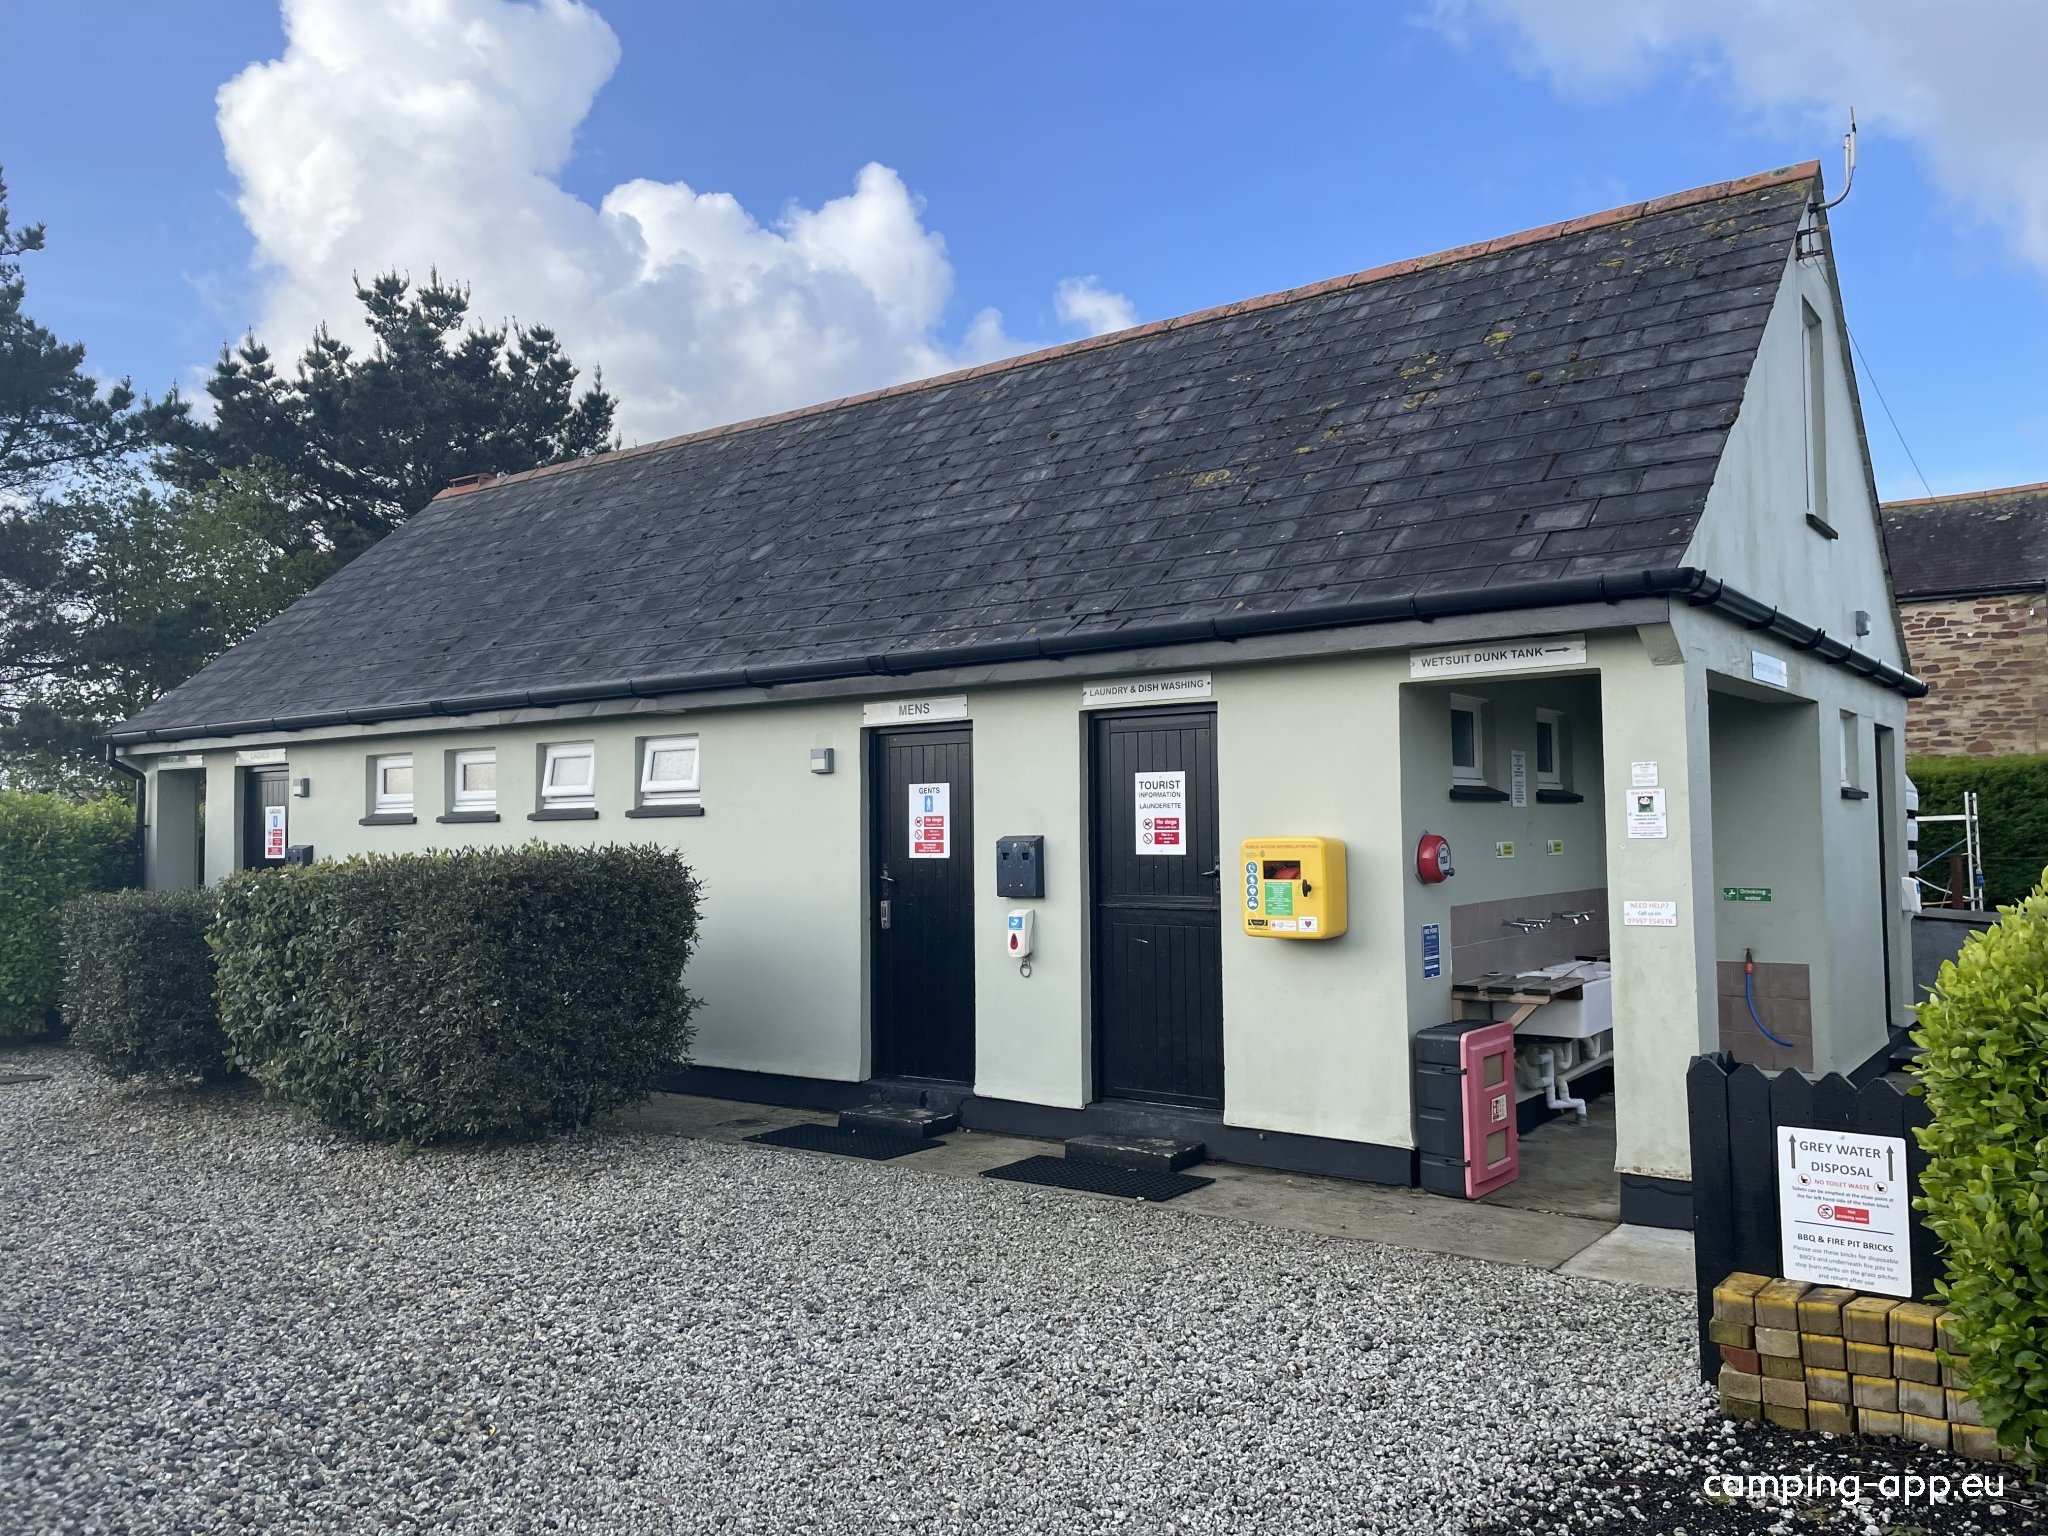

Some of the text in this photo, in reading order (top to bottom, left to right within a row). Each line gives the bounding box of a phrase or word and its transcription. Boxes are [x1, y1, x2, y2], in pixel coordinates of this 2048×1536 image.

[1421, 647, 1543, 667] WETSUIT DUNK TANK
[1089, 685, 1128, 696] LAUNDRY
[1138, 683, 1158, 693] DISH
[1160, 680, 1204, 691] WASHING
[898, 702, 930, 717] MENS
[1139, 780, 1180, 789] TOURIST
[1800, 1141, 1881, 1158] GREY WATER
[1811, 1162, 1873, 1177] DISPOSAL
[1798, 1233, 1816, 1243] BBQ
[1827, 1237, 1845, 1246] FIRE
[1848, 1239, 1860, 1248] PIT
[1863, 1241, 1894, 1252] BRICKS
[1829, 1257, 1862, 1267] underneath
[1840, 1250, 1857, 1259] bricks
[1868, 1254, 1899, 1264] disposable
[1877, 1272, 1898, 1281] pitches
